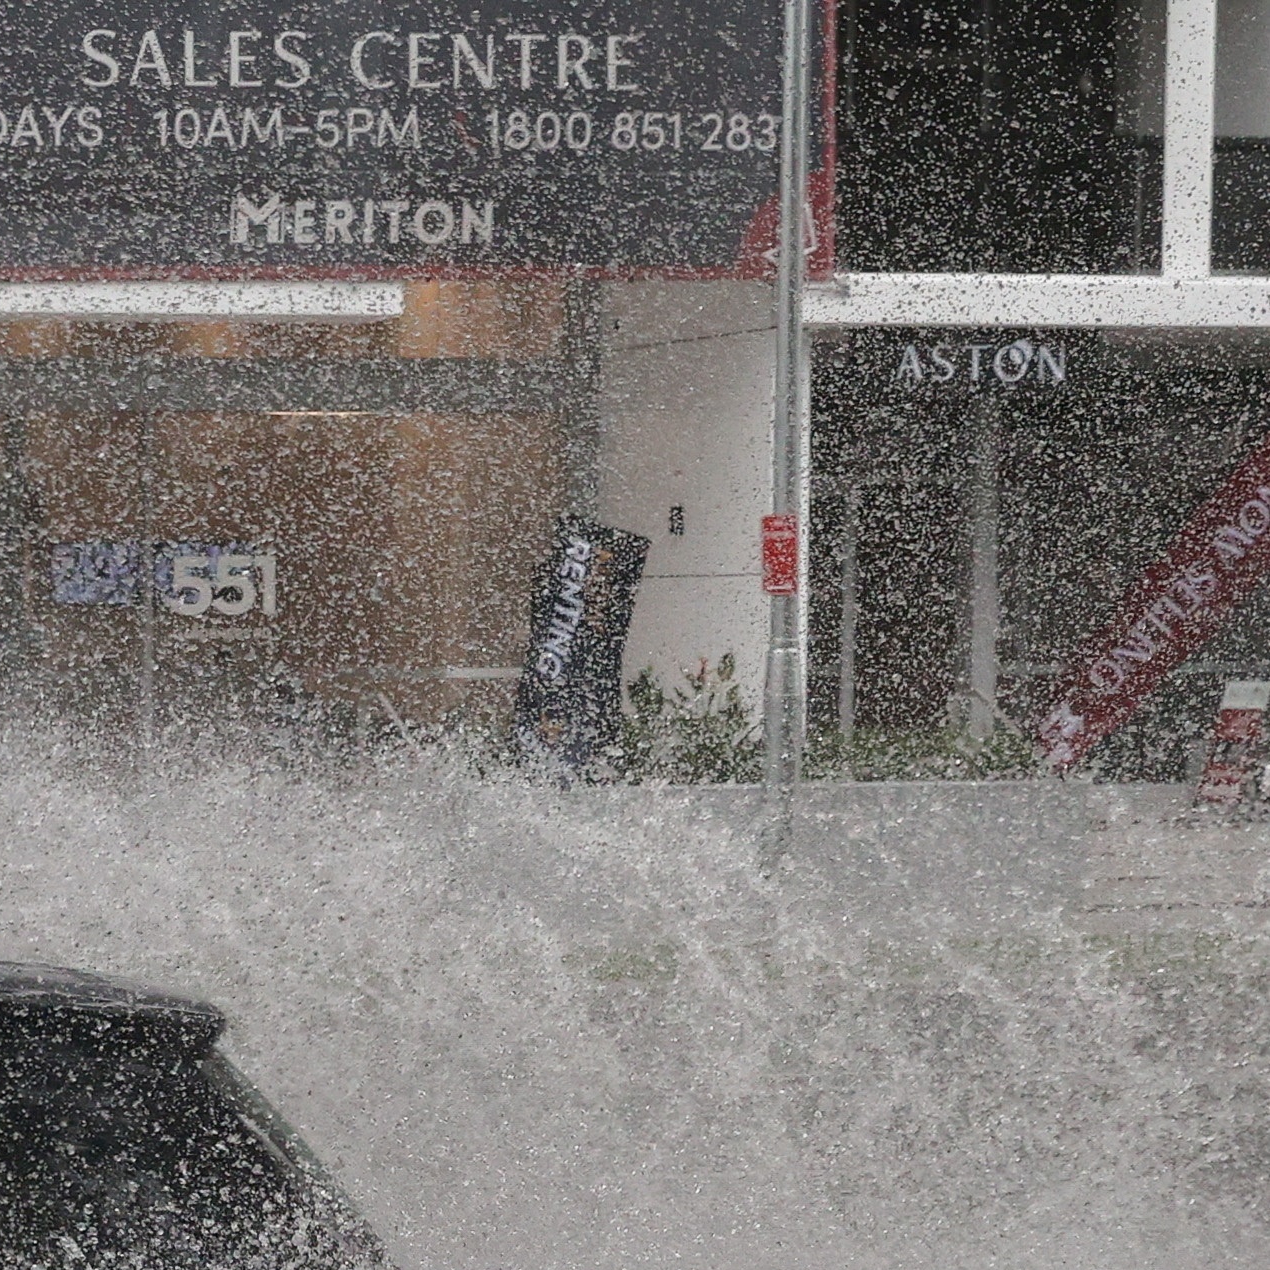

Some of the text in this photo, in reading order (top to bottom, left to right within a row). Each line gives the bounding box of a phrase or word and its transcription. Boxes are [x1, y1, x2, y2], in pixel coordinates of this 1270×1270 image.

[80, 28, 642, 91] SALES CENTRE
[154, 106, 422, 150] 10AM-5PM
[488, 108, 593, 151] 1800
[609, 109, 683, 151] 851
[700, 112, 778, 153] 283
[229, 192, 495, 244] MERITON
[895, 339, 1067, 383] ASTON
[163, 553, 277, 617] 551
[536, 536, 592, 680] RENTING
